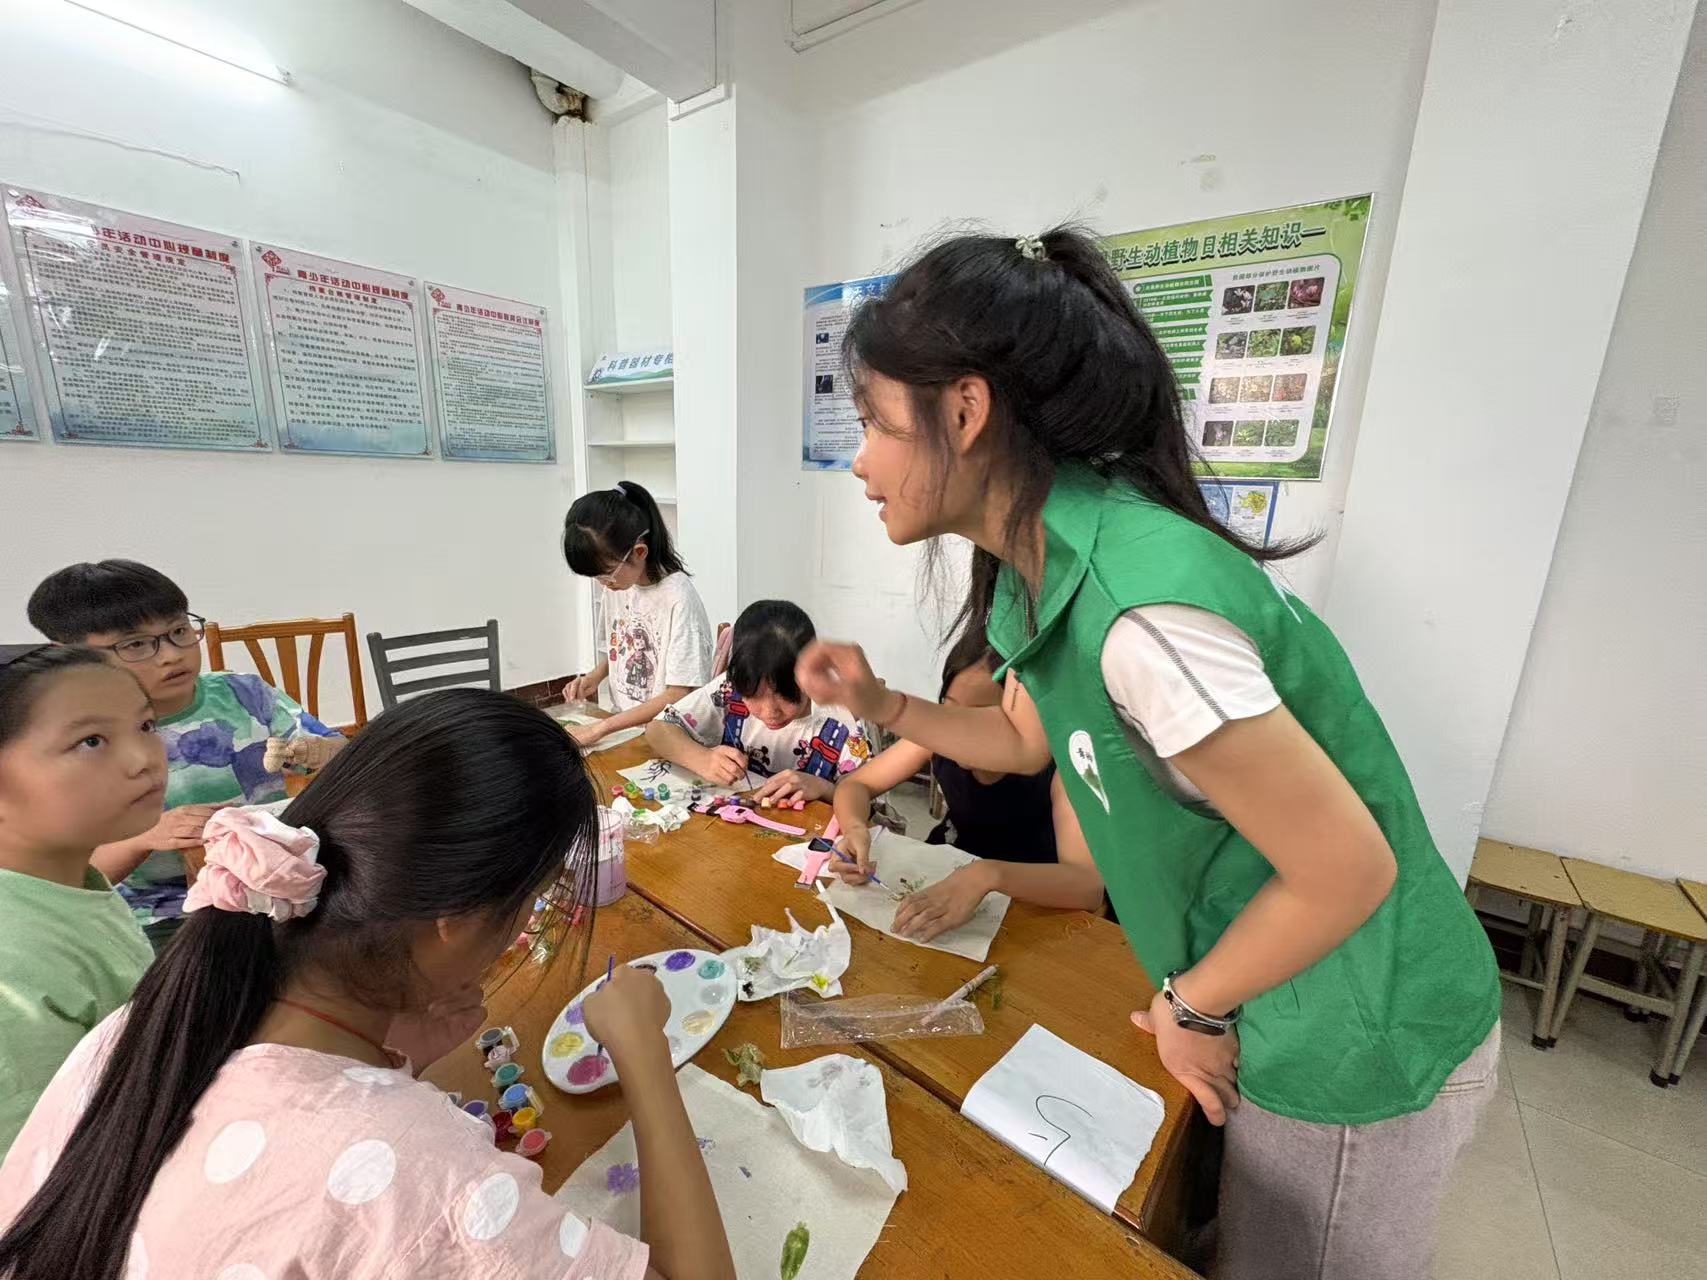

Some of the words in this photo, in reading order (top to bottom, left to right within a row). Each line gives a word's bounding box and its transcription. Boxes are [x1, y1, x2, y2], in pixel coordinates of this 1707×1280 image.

[1104, 221, 1327, 271] 野生动植物日相关知识一
